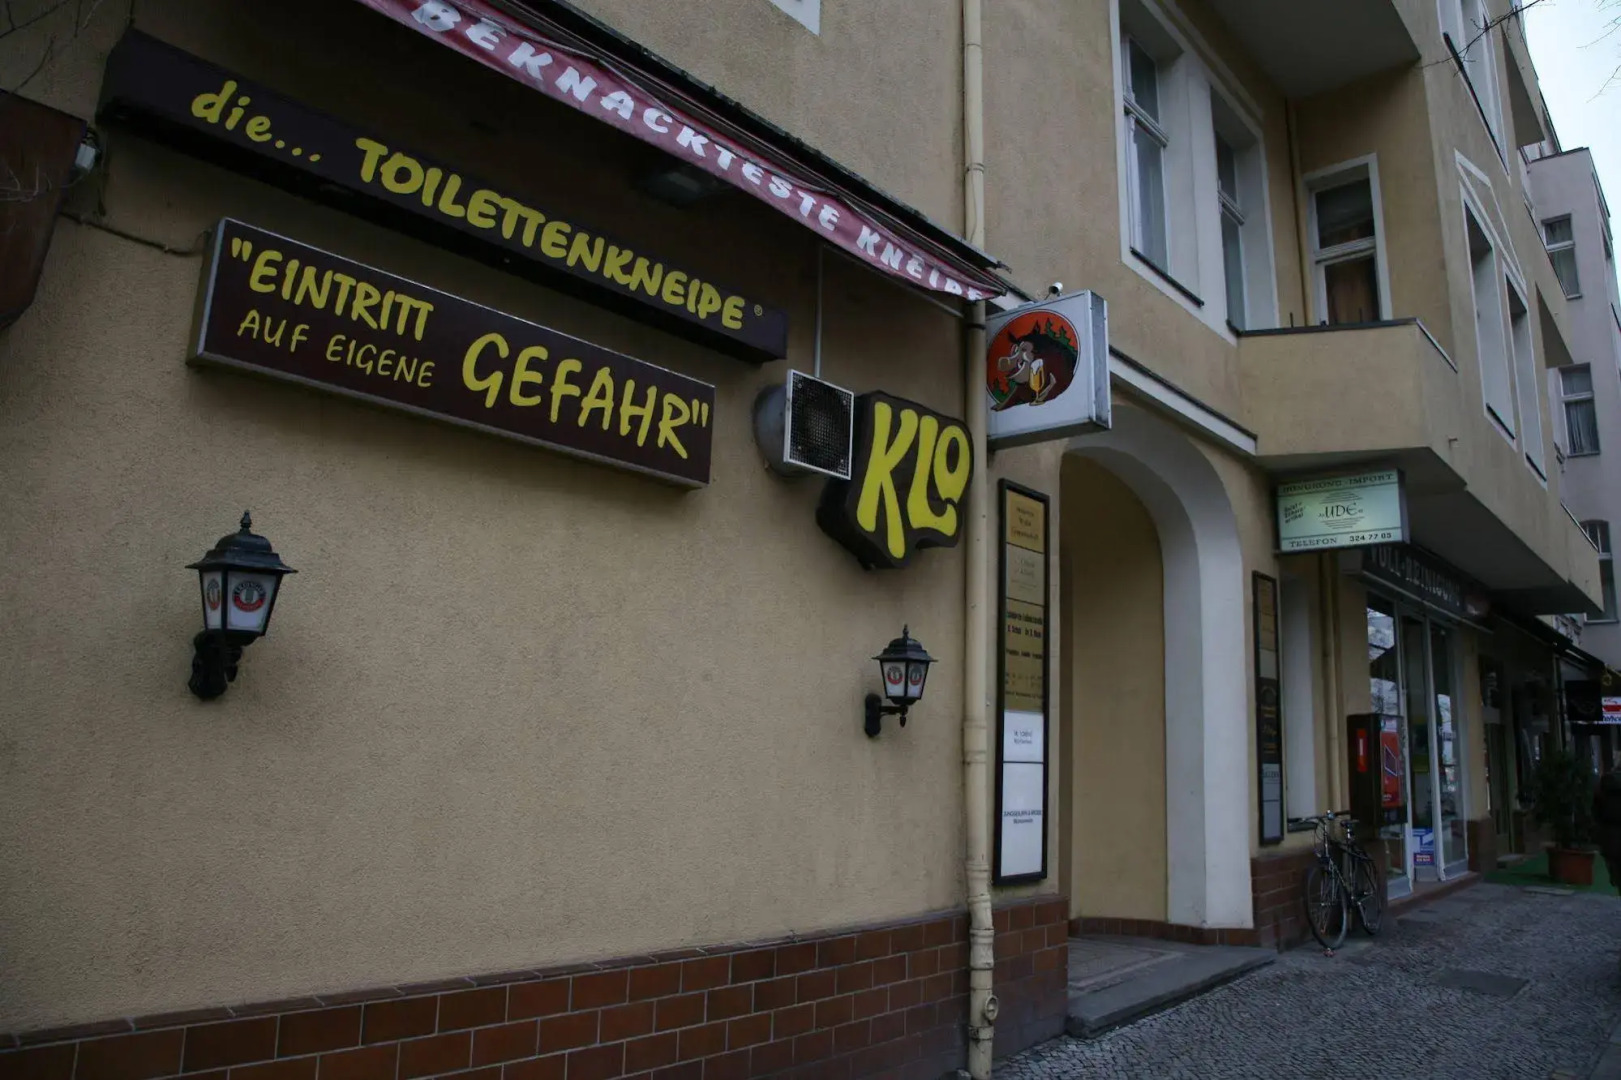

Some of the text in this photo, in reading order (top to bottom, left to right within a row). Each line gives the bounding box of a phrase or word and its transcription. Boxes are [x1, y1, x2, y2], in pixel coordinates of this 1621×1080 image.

[191, 80, 322, 163] die...
[410, 0, 840, 232] BEKNACKTESTE
[231, 238, 435, 342] "EINTRITT
[237, 309, 437, 389] AUF EIGENE
[462, 333, 709, 460] GEFAHR"
[856, 401, 971, 559] KLO
[1349, 473, 1394, 486] IMPORT
[1289, 538, 1337, 548] TELEFON
